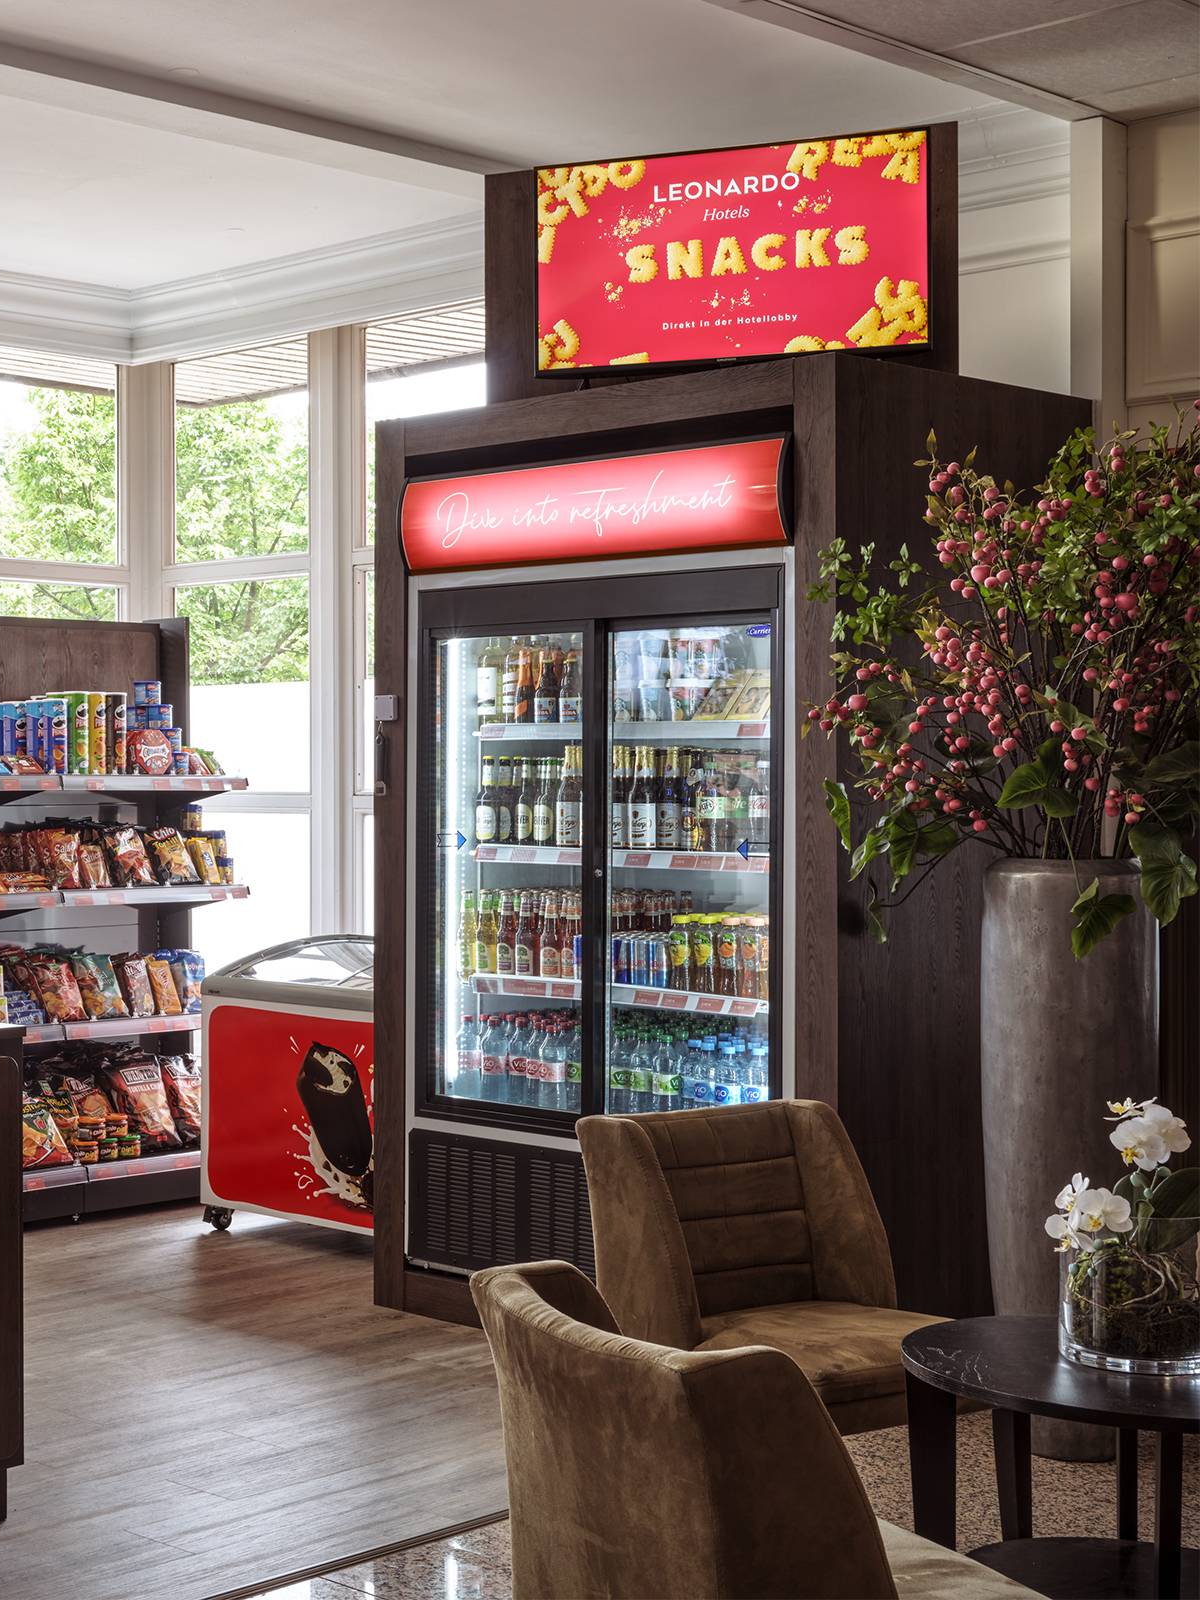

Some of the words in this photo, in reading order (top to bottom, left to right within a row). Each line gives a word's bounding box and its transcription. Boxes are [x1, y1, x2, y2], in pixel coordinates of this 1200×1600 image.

[653, 172, 800, 203] LEONARDO
[703, 205, 750, 221] Hotels
[625, 225, 871, 284] SNACKS
[662, 321, 696, 330] Direkt
[715, 318, 732, 327] der
[737, 313, 798, 324] Hotellobby
[436, 491, 504, 549] Dive
[512, 494, 559, 527] into
[568, 470, 736, 537] refreshment
